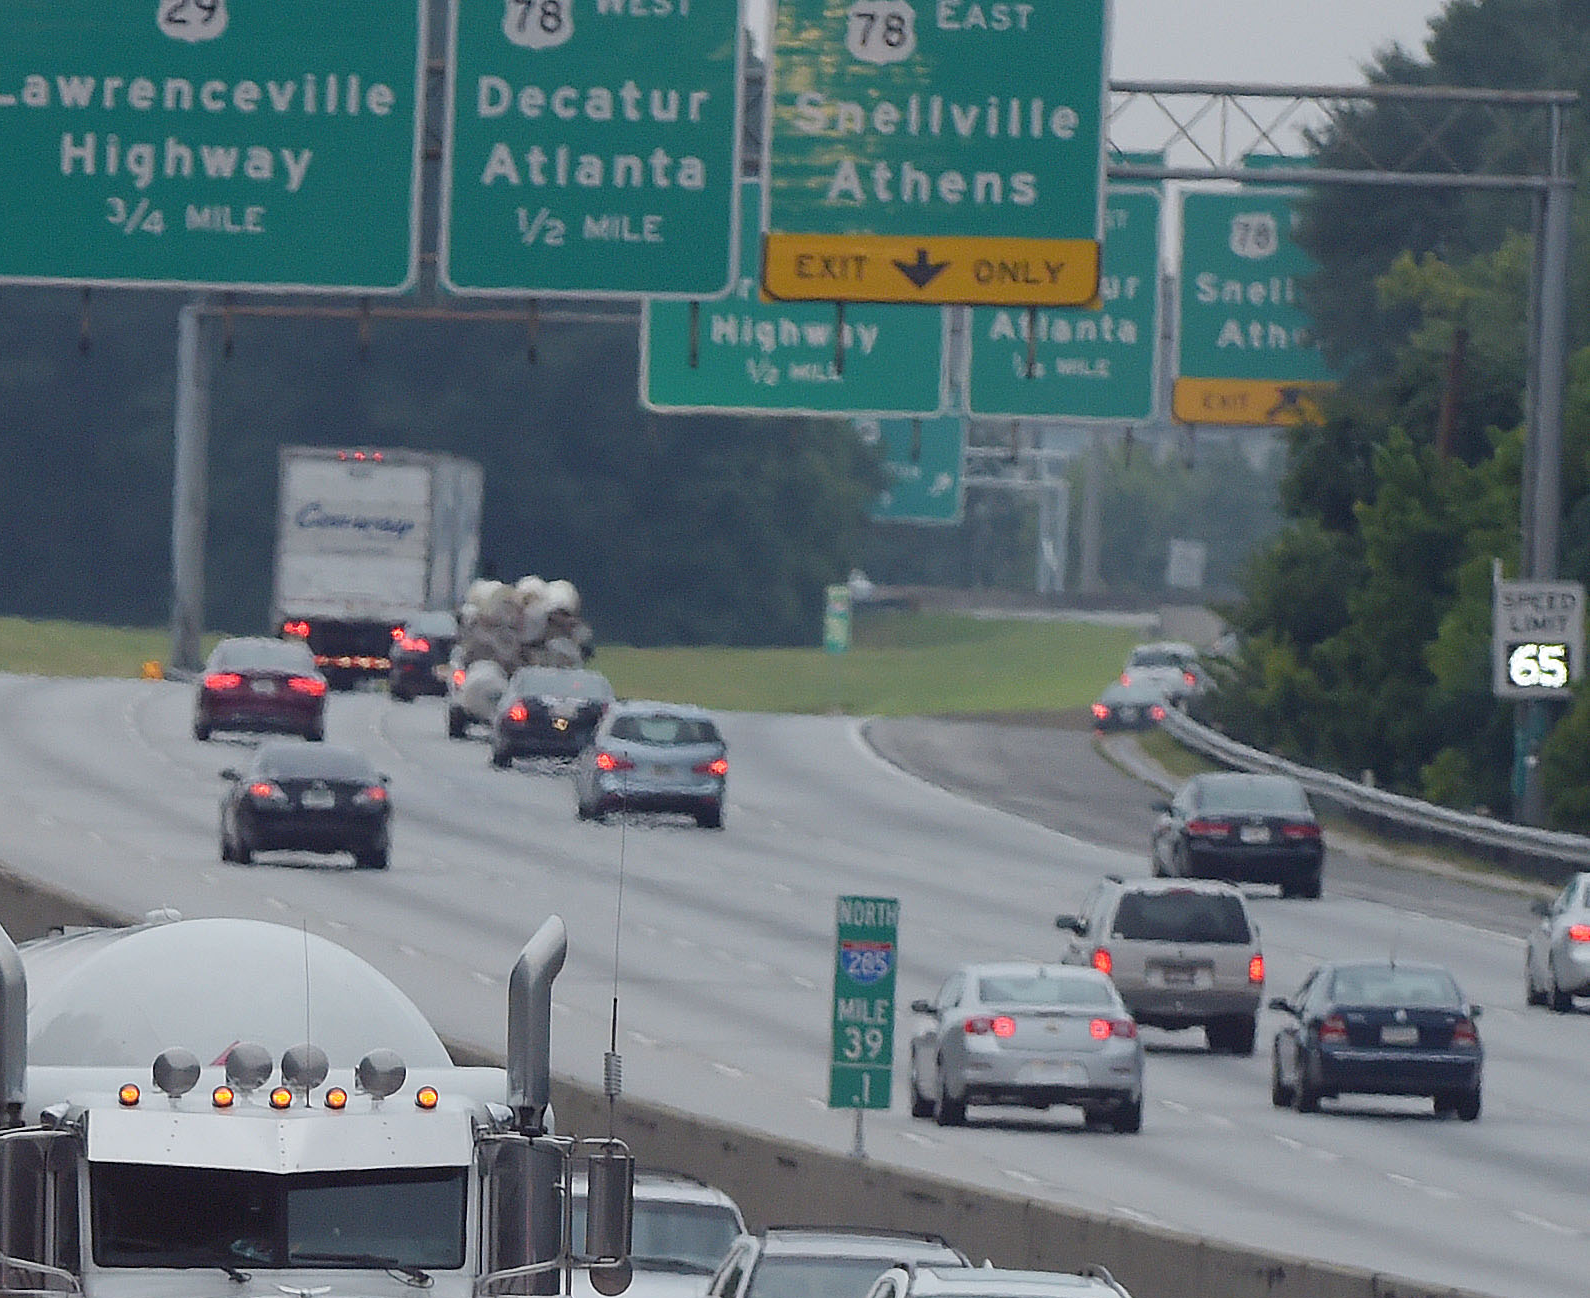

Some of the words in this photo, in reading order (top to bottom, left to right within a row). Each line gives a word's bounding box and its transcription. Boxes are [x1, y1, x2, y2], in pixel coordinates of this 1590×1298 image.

[164, 0, 217, 25] 29
[512, 0, 561, 33] 78
[936, 0, 1034, 30] EAST
[855, 12, 906, 48] 78
[477, 75, 710, 122] Decatur
[795, 92, 1079, 139] Snellville
[61, 132, 313, 192] Highway
[480, 143, 706, 190] Atlanta
[826, 160, 1038, 205] Athens
[185, 204, 266, 233] MILE
[582, 214, 664, 242] MILE
[794, 254, 868, 281] EXIT
[973, 259, 1067, 286] ONLY
[989, 310, 1138, 345] Atlanta
[1502, 591, 1577, 611] SPEED
[1508, 614, 1568, 633] LIMIT
[1508, 644, 1568, 688] 65
[838, 899, 899, 926] NORTH
[837, 998, 889, 1025] MILE
[843, 1026, 883, 1059] 39
